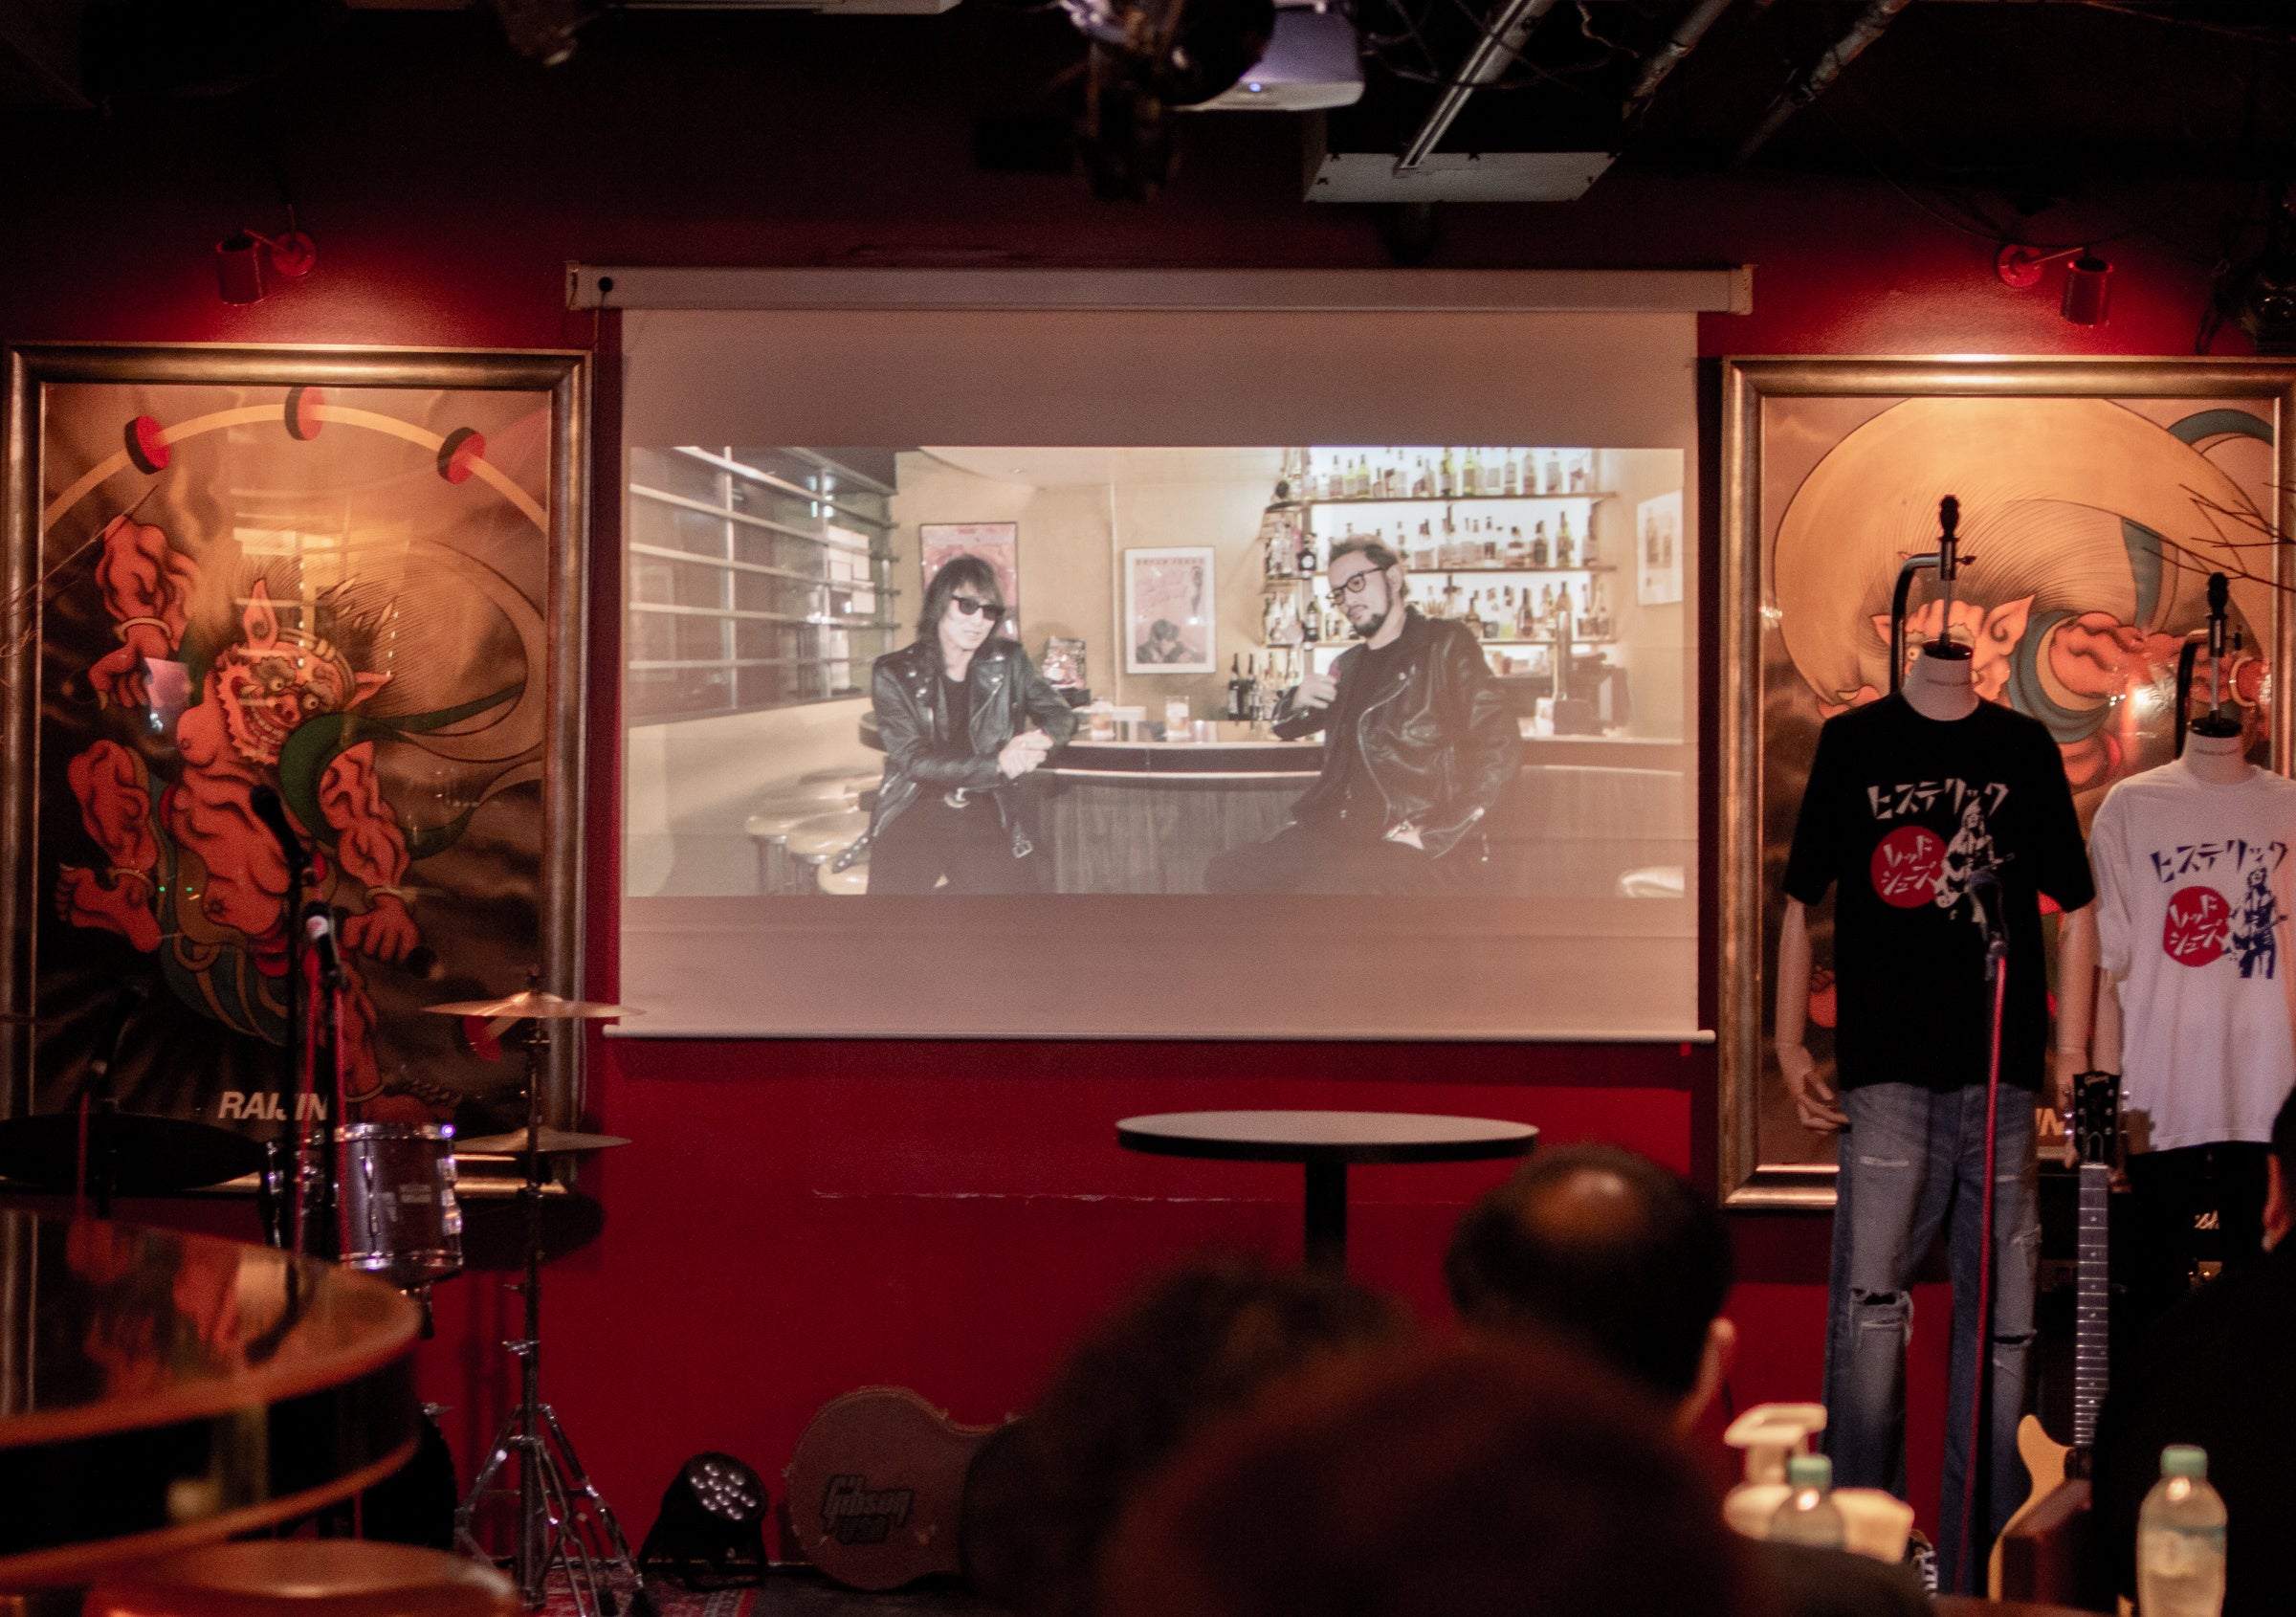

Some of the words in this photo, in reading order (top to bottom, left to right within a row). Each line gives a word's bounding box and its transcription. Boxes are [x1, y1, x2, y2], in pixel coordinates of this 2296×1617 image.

[1866, 778, 2010, 820] ヒステリック
[1883, 834, 1932, 868] レッド
[2150, 839, 2288, 883] ヒステリック
[2170, 895, 2218, 928] レッド
